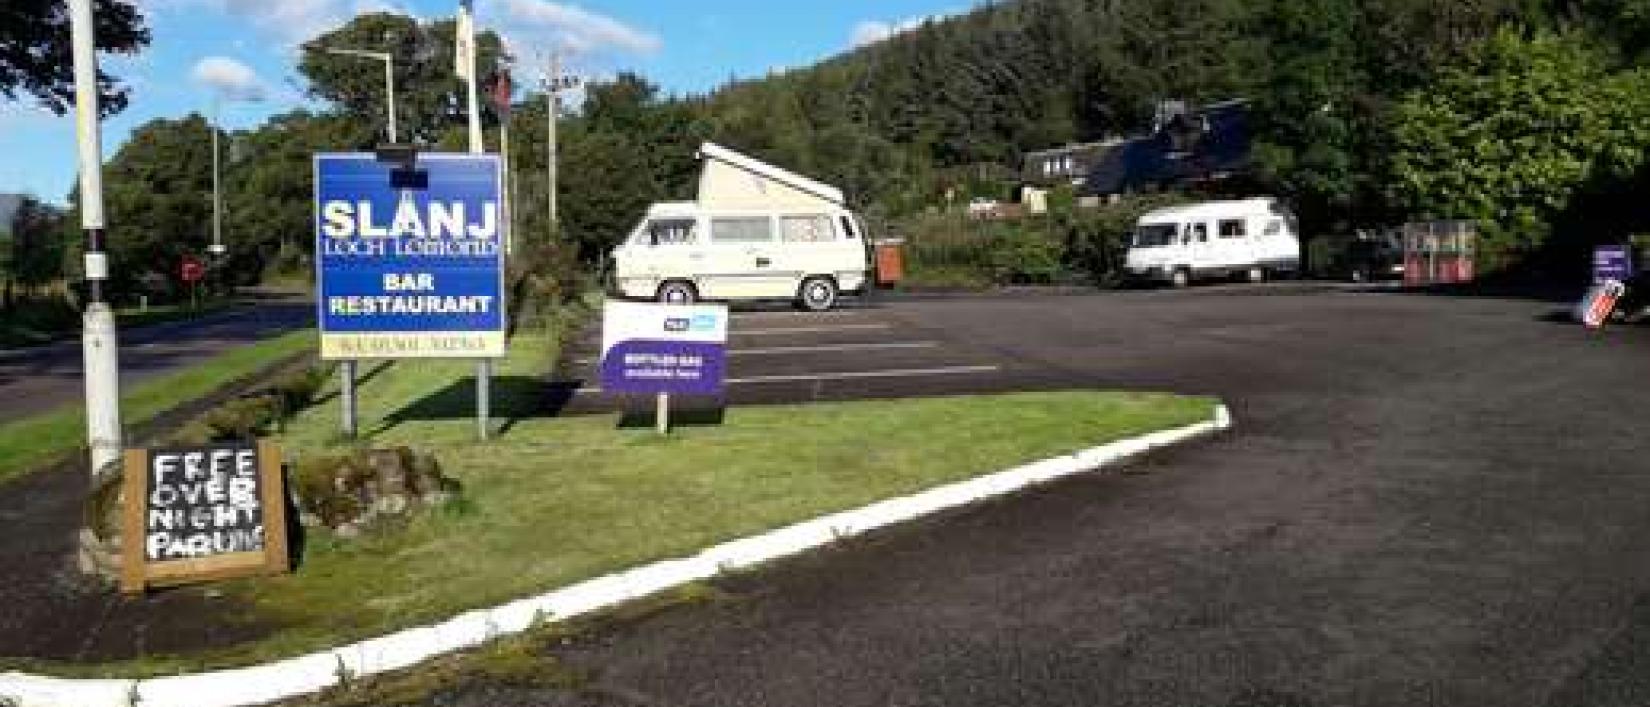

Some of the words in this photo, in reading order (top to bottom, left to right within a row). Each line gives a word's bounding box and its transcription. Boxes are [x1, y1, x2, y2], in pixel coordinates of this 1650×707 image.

[382, 273, 435, 291] BAR
[328, 295, 493, 315] RESTAURANT
[153, 448, 255, 482] FREE
[149, 477, 258, 508] OVER
[149, 504, 254, 530] NIGHT
